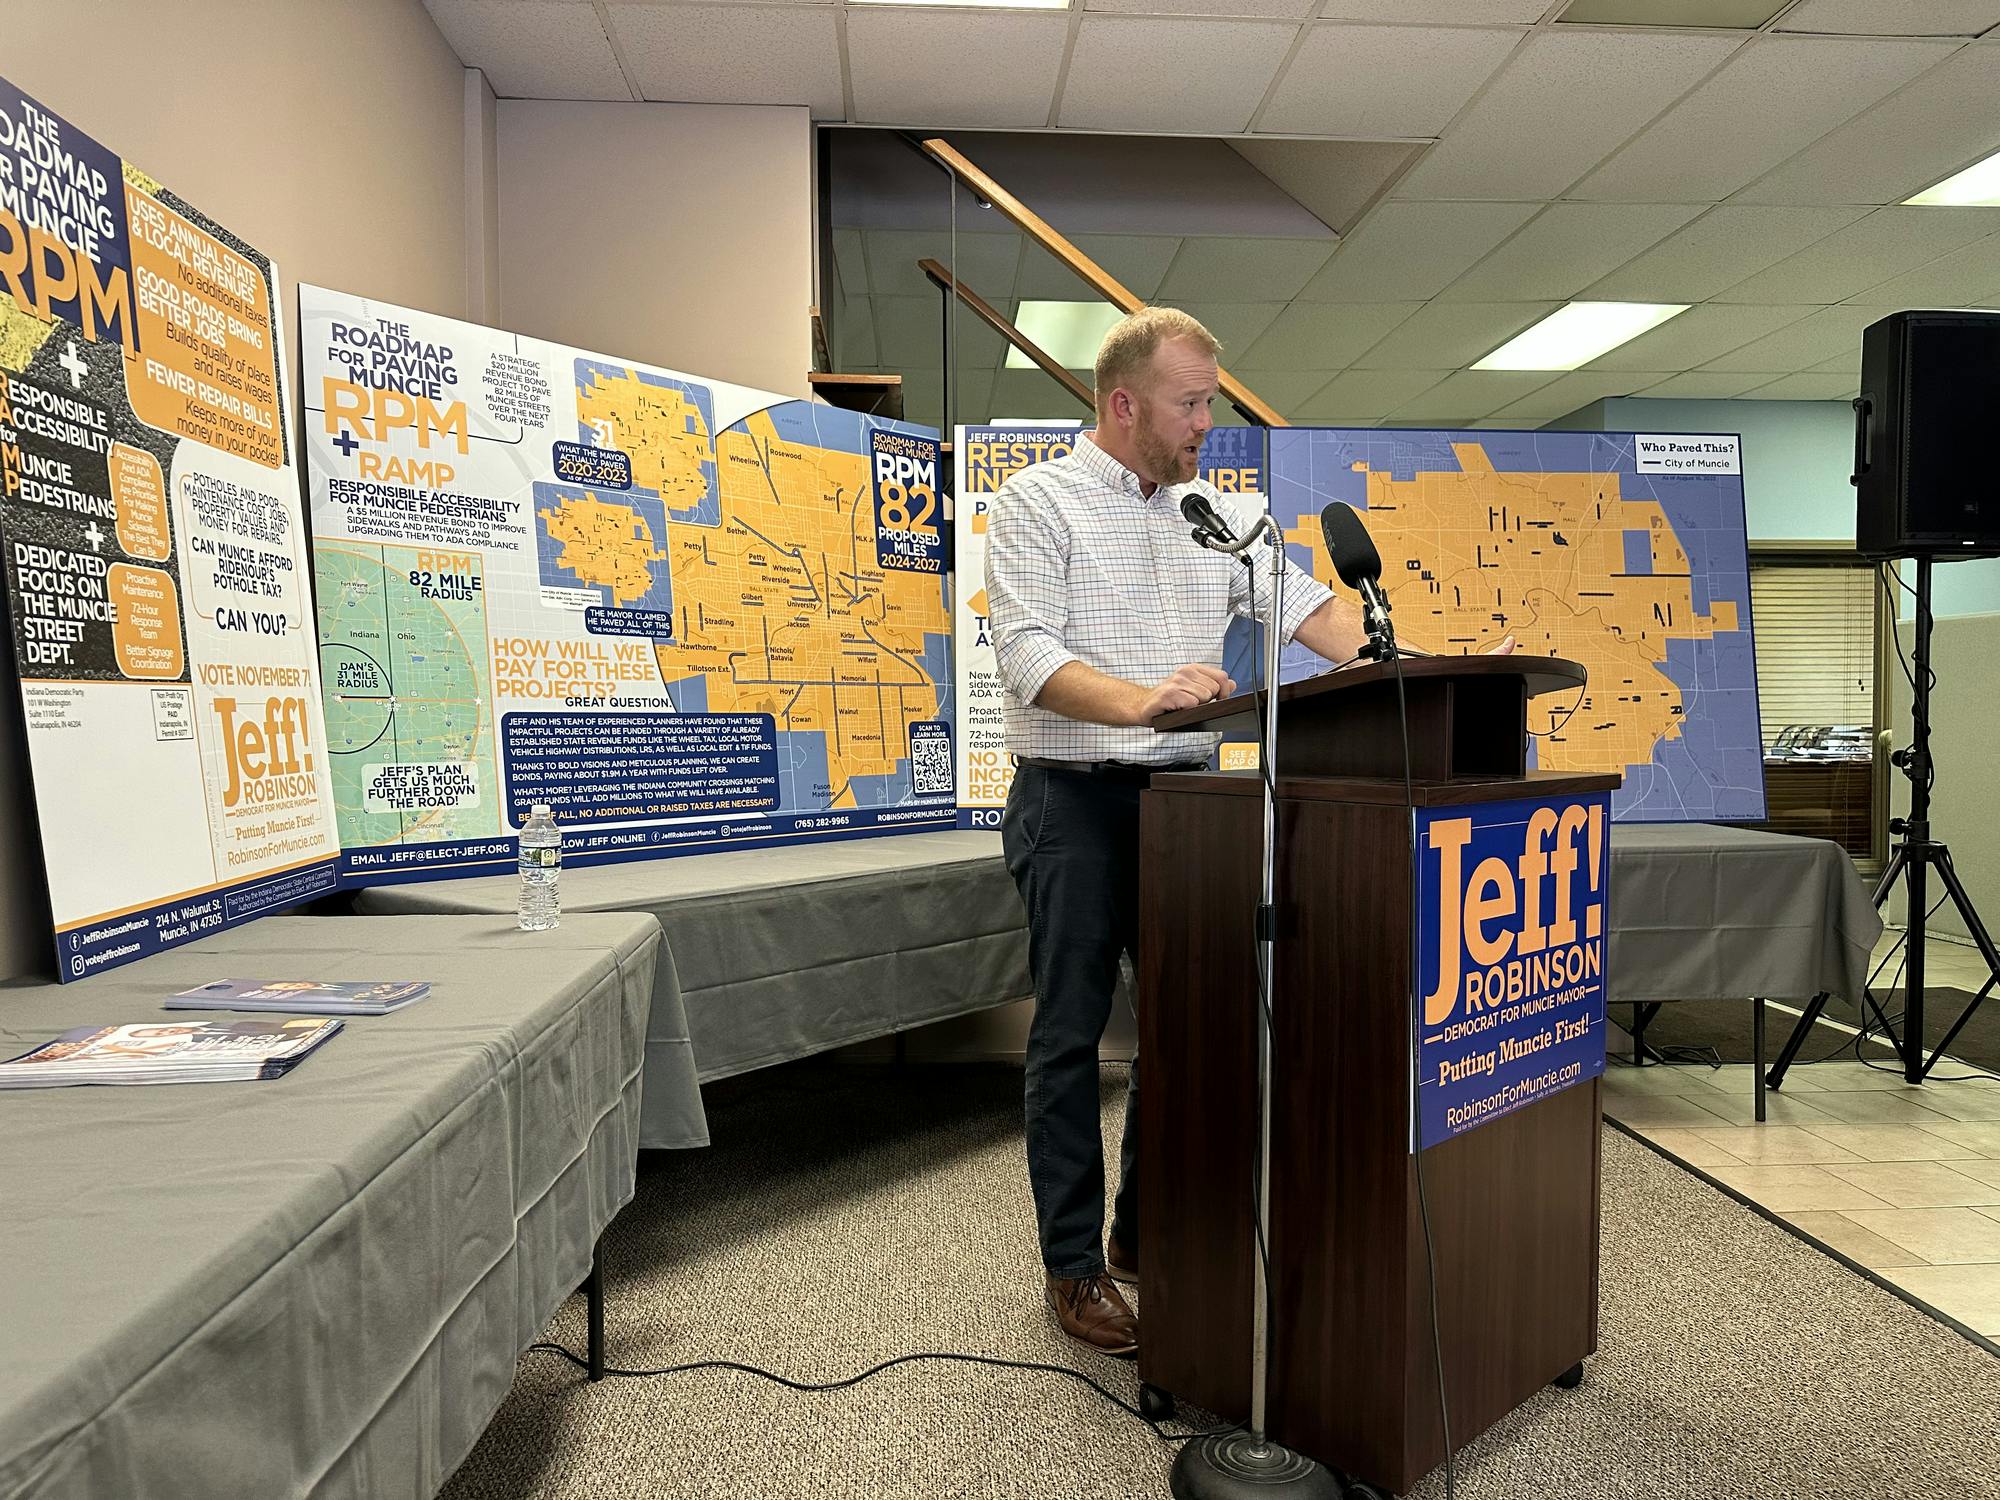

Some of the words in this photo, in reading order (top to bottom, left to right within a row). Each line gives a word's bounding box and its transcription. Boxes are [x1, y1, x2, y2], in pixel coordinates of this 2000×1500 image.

[21, 101, 60, 145] THE
[20, 152, 114, 238] PAVING
[376, 319, 410, 338] THE
[331, 323, 453, 364] ROADMAP
[328, 347, 365, 367] FOR
[372, 351, 458, 385] PAVING
[349, 366, 442, 401] MUNCIE
[146, 359, 196, 398] FEWER
[199, 380, 241, 414] REPAIR
[243, 403, 272, 430] BILLS
[323, 376, 469, 455] RPM
[590, 417, 614, 441] 31
[968, 433, 996, 442] JEFF
[1000, 433, 1071, 443] ROBINSON'S
[556, 444, 580, 455] WHAT
[582, 447, 598, 458] THE
[600, 450, 626, 463] MAYOR
[770, 449, 802, 461] Rosewood
[1640, 442, 1666, 453] Who
[1669, 443, 1702, 453] Paved
[1704, 443, 1734, 453] This?
[2, 441, 74, 486] MUNCIE
[359, 452, 455, 489] RAMP
[560, 453, 597, 467] ACTUALLY
[600, 459, 624, 471] PAVED
[729, 455, 760, 467] Wheeling
[1665, 460, 1683, 468] City
[1697, 460, 1730, 468] Muncie
[558, 461, 627, 482] 2020-2023
[876, 452, 936, 492] RPM
[4, 471, 118, 520] PEDESTRIANS
[329, 479, 427, 502] RESPONSIBILE
[431, 491, 520, 514] ACCESSIBILITY
[880, 480, 938, 534] 82
[727, 527, 748, 536] Bethel
[878, 527, 941, 546] PROPOSED
[684, 543, 701, 551] Petty
[894, 542, 927, 558] MILES
[14, 542, 106, 577] DEDICATED
[417, 552, 472, 576] RPM
[748, 553, 765, 562] Petty
[881, 554, 941, 571] 2024-2027
[773, 564, 802, 574] Wheeling
[861, 570, 885, 578] Highland
[18, 570, 75, 595] FOCUS
[78, 578, 103, 599] ON
[409, 571, 433, 587] 82
[439, 575, 482, 591] MILE
[761, 576, 790, 585] Riverside
[421, 588, 473, 601] RADIUS
[741, 593, 763, 601] Gilbert
[20, 591, 62, 617] THE
[65, 598, 118, 623] MUNCIE
[787, 601, 816, 610] University
[216, 608, 247, 632] CAN
[252, 613, 286, 636] YOU?
[587, 617, 598, 626] HE
[600, 618, 623, 627] PAVED
[627, 619, 641, 628] ALL
[642, 621, 653, 629] OF
[654, 622, 670, 630] THIS
[589, 609, 604, 618] THE
[607, 610, 632, 620] MAYOR
[635, 612, 666, 622] CLAIMED
[704, 618, 734, 627] Stradling
[786, 621, 810, 629] Jackson
[24, 617, 85, 642] STREET
[350, 631, 380, 639] Indiana
[397, 633, 416, 641] Ohio
[27, 641, 75, 665] DEPT.
[494, 638, 550, 658] HOW
[556, 640, 609, 660] WILL
[613, 643, 648, 662] WE
[680, 643, 717, 651] Hawthorne
[197, 664, 234, 685] VOTE
[237, 665, 299, 687] NOVEMBER
[302, 670, 311, 688] 7!
[338, 671, 349, 679] 31
[352, 671, 378, 680] MILE
[340, 662, 374, 671] DAN'S
[495, 659, 536, 678] PAY
[544, 661, 587, 679] FOR
[593, 662, 656, 681] THESE
[687, 665, 715, 673] Tillotson
[969, 671, 992, 680] New
[337, 680, 379, 689] RADIUS
[496, 680, 616, 699] PROJECTS?
[779, 688, 795, 696] Hoyt
[969, 690, 992, 698] ADA
[565, 697, 605, 708] GREAT
[611, 697, 673, 708] QUESTION.
[214, 696, 313, 807] Jeff!
[969, 752, 998, 766] NO
[380, 766, 424, 776] JEFF'S
[427, 766, 462, 776] PLAN
[512, 773, 542, 782] BONDS,
[544, 772, 571, 780] PAYING
[574, 771, 600, 779] ABOUT
[601, 770, 620, 778] $1.9M
[629, 769, 648, 777] YEAR
[244, 773, 316, 805] ROBINSON
[373, 777, 408, 788] GETS
[412, 777, 430, 787] US
[433, 775, 469, 786] MUCH
[368, 787, 429, 799] FURTHER
[434, 785, 476, 797] DOWN
[388, 798, 415, 808] THE
[420, 796, 459, 807] ROAD!
[795, 819, 814, 829] (765)
[816, 816, 849, 827] 282-9965
[878, 810, 957, 822] ROBINSONFORMUNCIE.COM
[228, 833, 325, 866] RobinsonForMuncie.com
[351, 853, 387, 866] EMAIL
[389, 844, 510, 863] JEFF@ELECT-JEFF.ORG
[155, 914, 170, 928] 214
[171, 910, 180, 924] N.
[181, 901, 212, 922] Walunut
[214, 899, 222, 912] St.
[1424, 804, 1603, 1026] Jeff!
[160, 922, 189, 943] Muncie,
[190, 920, 199, 933] IN
[200, 913, 222, 931] 47305
[1465, 940, 1601, 1015] ROBINSON
[1443, 1009, 1498, 1044] DEMOCRAT
[1500, 1003, 1520, 1023] FOR
[1521, 994, 1554, 1017] MUNCIE
[1556, 985, 1585, 1006] MAYOR
[1438, 1048, 1496, 1087] Putting
[1499, 1027, 1552, 1066] Muncie
[1555, 1013, 1589, 1045] First!
[1446, 1061, 1581, 1128] RobinsonForMuncie.com
